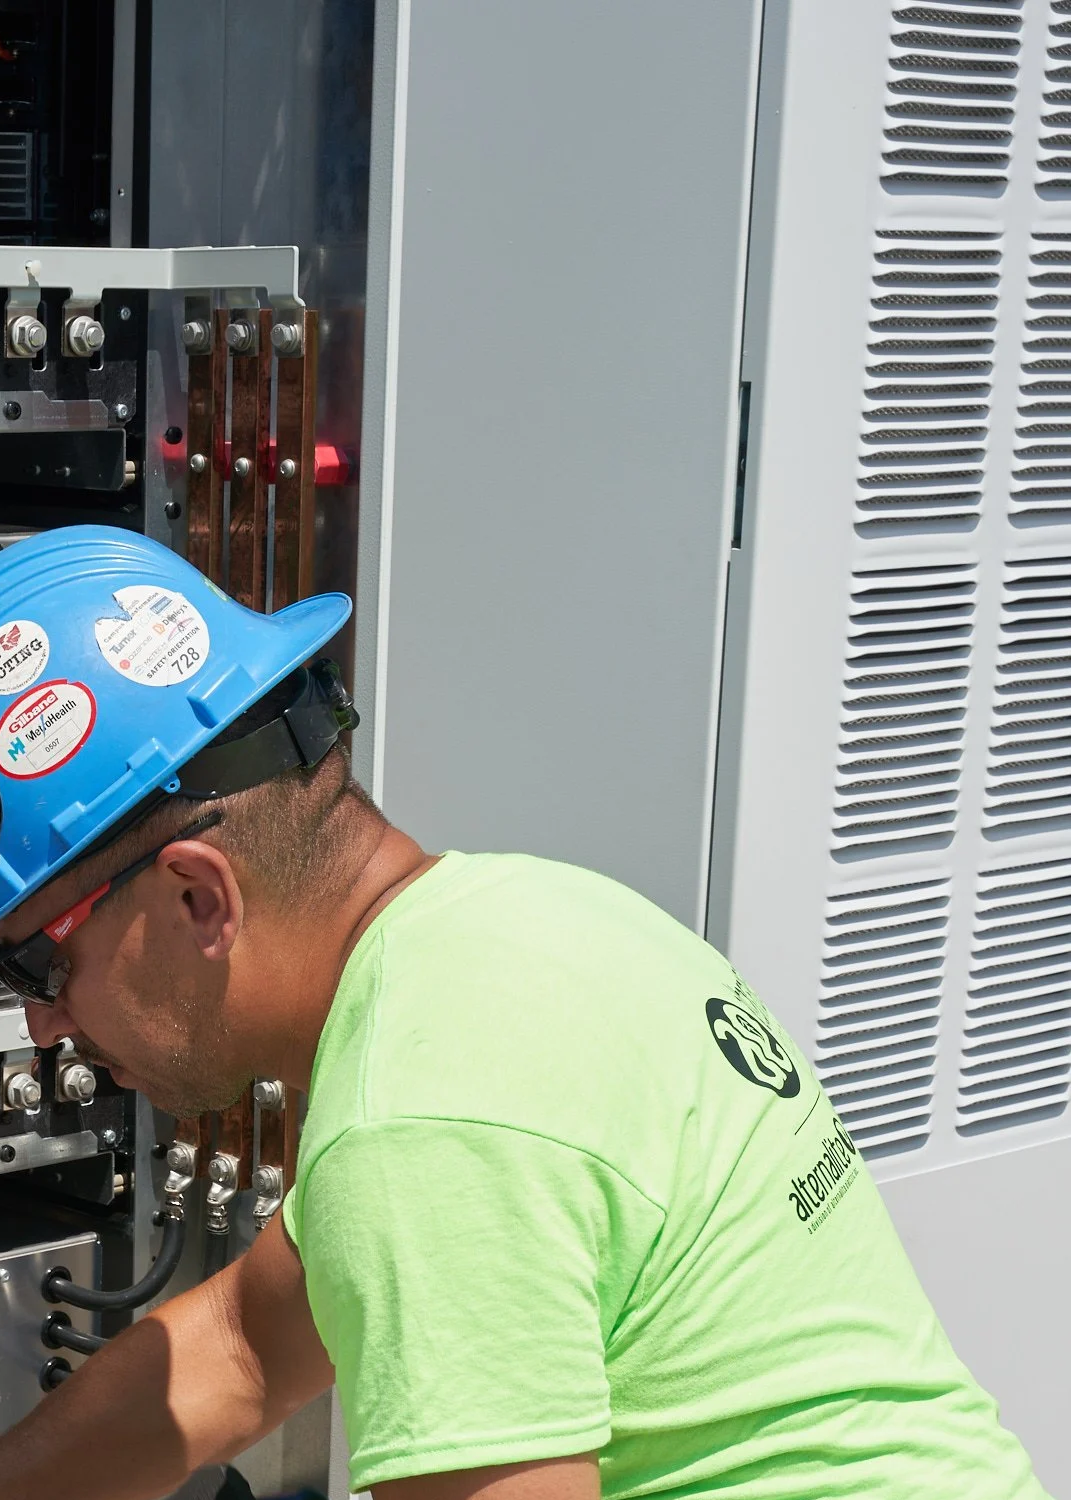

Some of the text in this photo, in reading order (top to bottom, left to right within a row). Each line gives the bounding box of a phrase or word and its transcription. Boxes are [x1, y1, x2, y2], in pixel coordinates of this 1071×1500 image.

[147, 626, 201, 679] SAFETY ORIENTATION
[171, 647, 200, 675] 728
[9, 693, 57, 734] Gilbane
[45, 738, 60, 753] 0507
